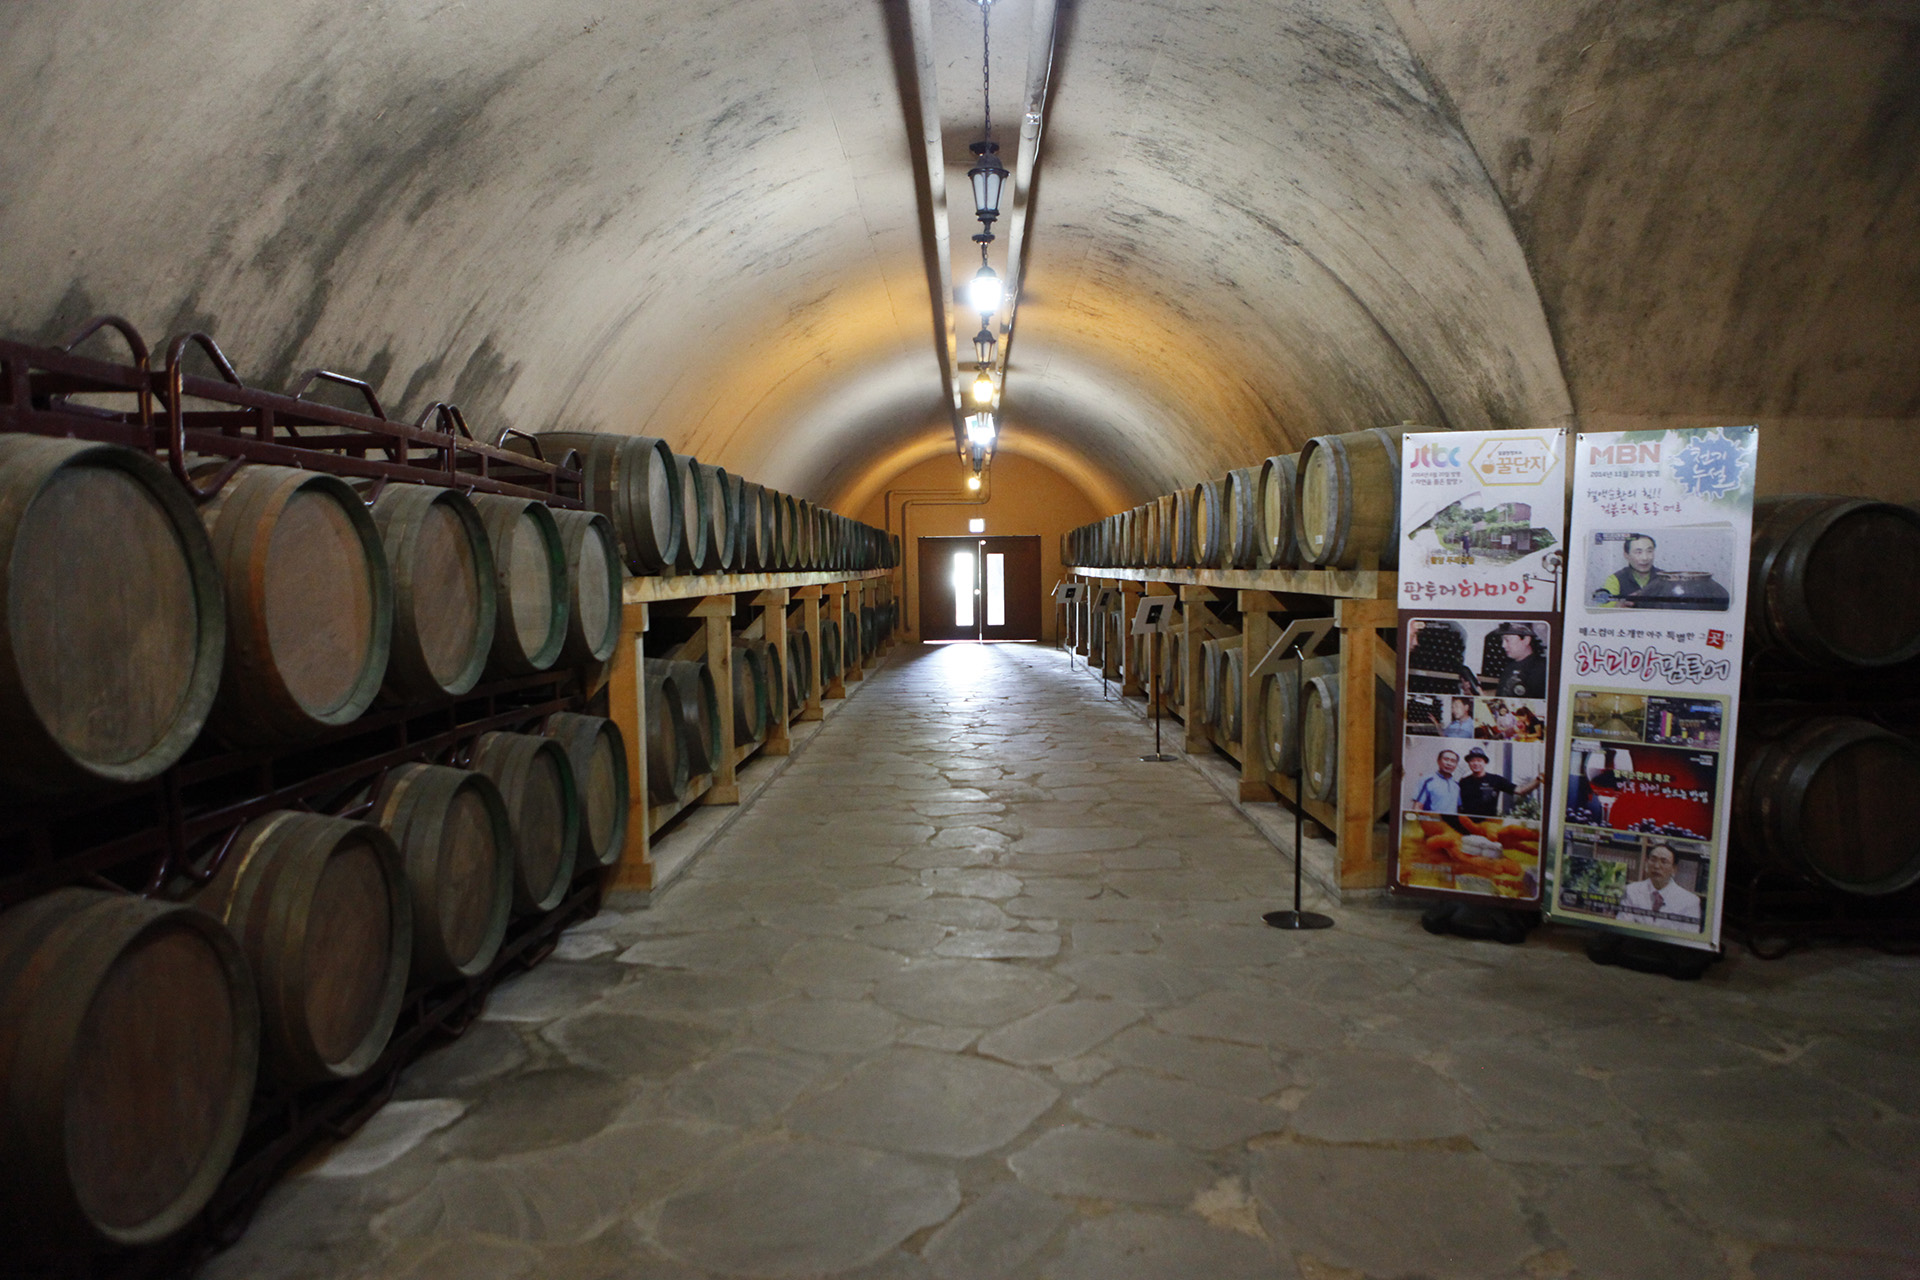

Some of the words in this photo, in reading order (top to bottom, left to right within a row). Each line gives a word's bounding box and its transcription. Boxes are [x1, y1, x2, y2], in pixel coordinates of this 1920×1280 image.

[1589, 444, 1660, 465] MBN
[1496, 456, 1546, 474] 꿀단지
[1587, 487, 1637, 503] 혈액순환의
[1579, 627, 1615, 638] 매스컴이
[1616, 628, 1645, 639] 소개한
[1646, 630, 1663, 639] 아주
[1665, 630, 1695, 643] 특별한
